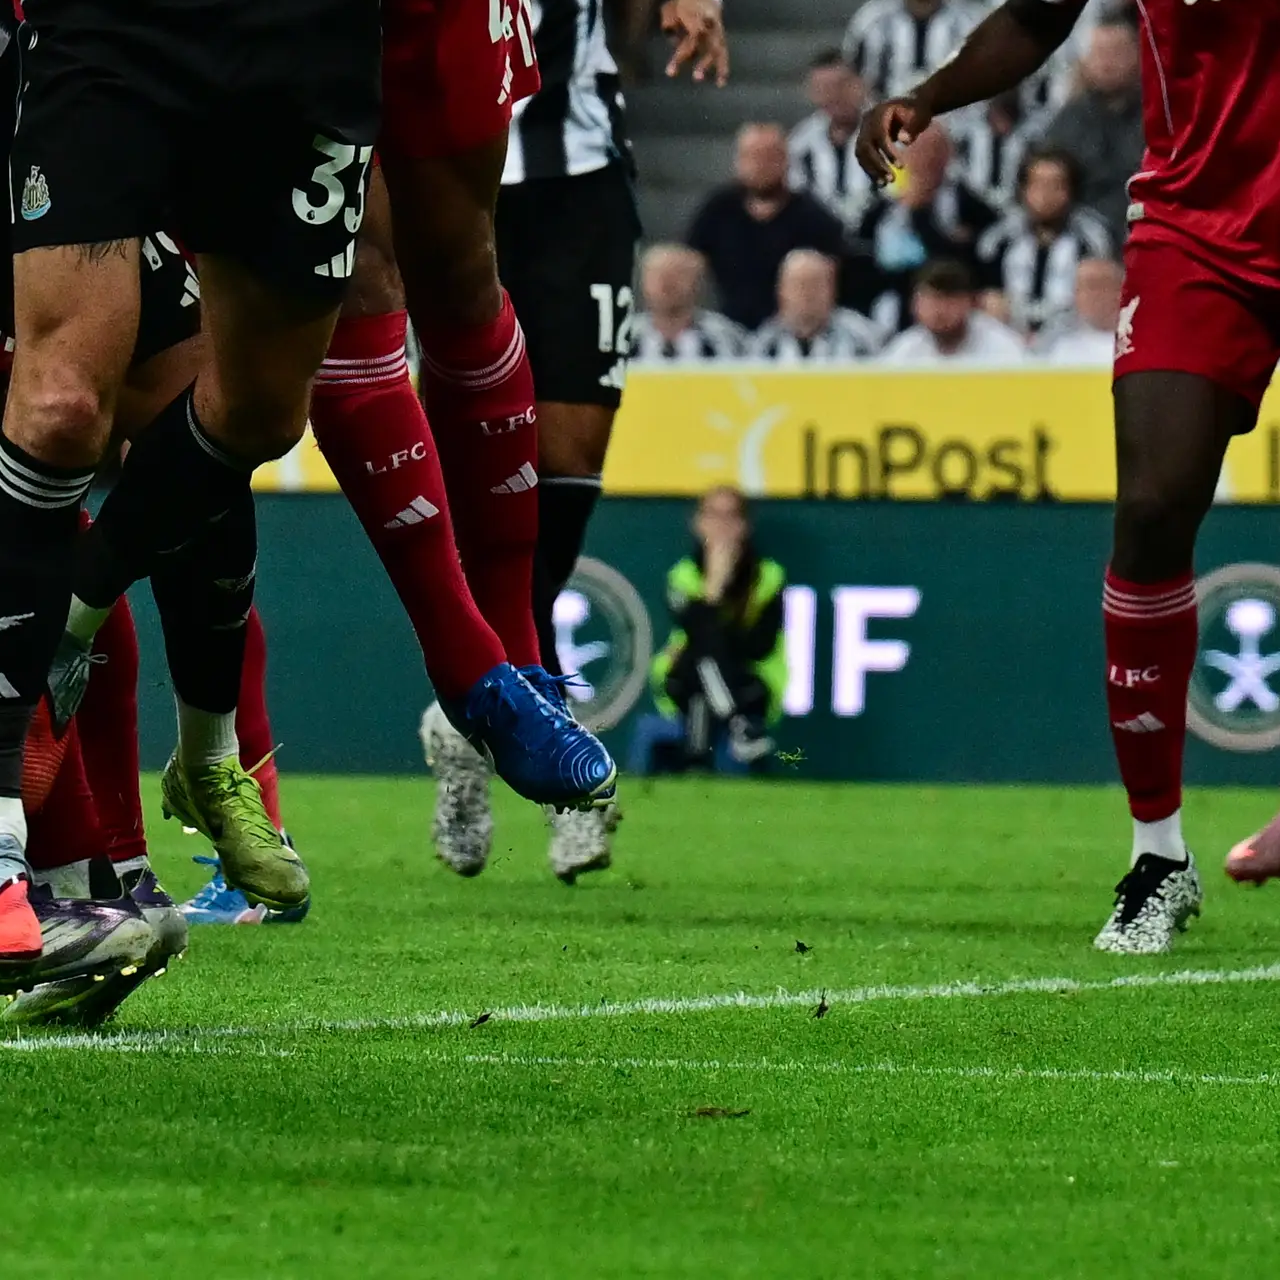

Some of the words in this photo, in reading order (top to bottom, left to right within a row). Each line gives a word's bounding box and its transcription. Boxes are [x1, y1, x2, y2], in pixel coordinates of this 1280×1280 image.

[482, 405, 536, 436] LFC
[365, 441, 426, 475] LFC
[802, 421, 1056, 501] InPost
[782, 584, 923, 718] IF
[1108, 664, 1161, 688] LFC
